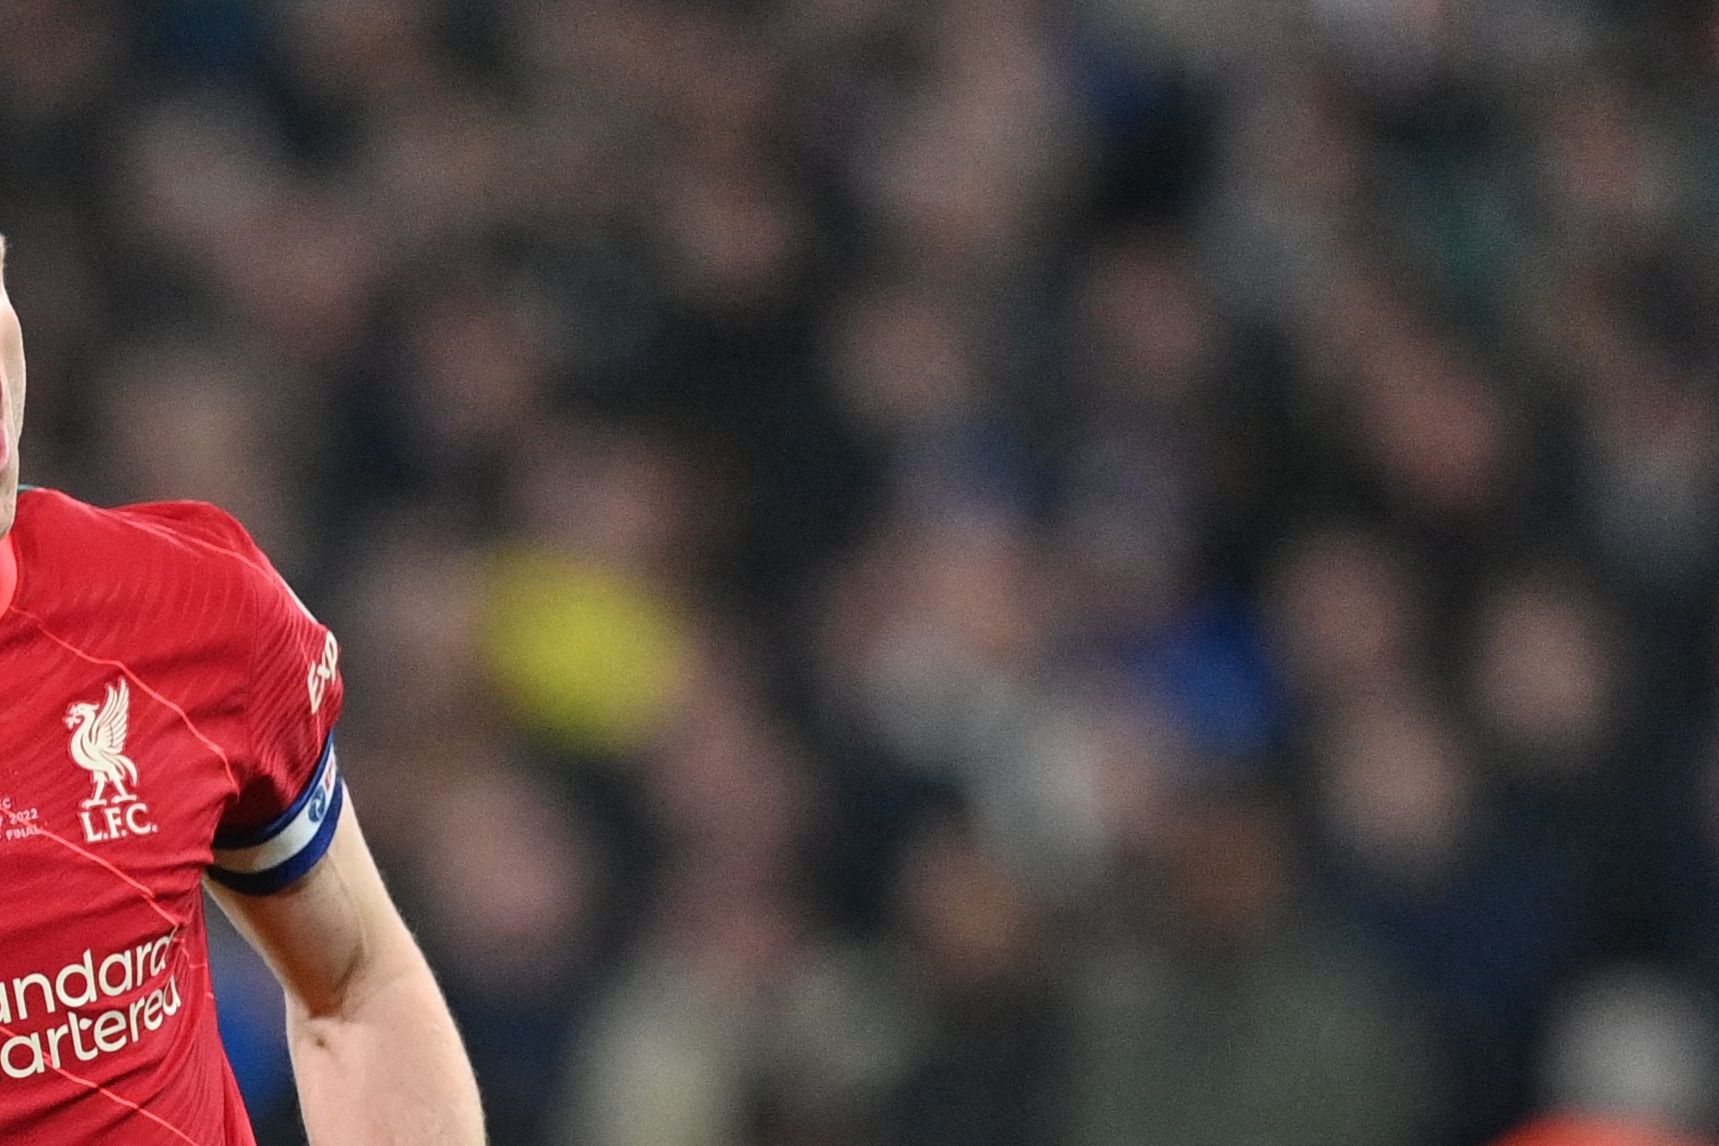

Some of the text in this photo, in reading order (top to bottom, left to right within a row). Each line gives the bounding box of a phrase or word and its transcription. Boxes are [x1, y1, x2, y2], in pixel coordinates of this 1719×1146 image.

[8, 807, 39, 825] 2022
[80, 803, 158, 842] L.F.C.
[5, 824, 41, 841] FINAL
